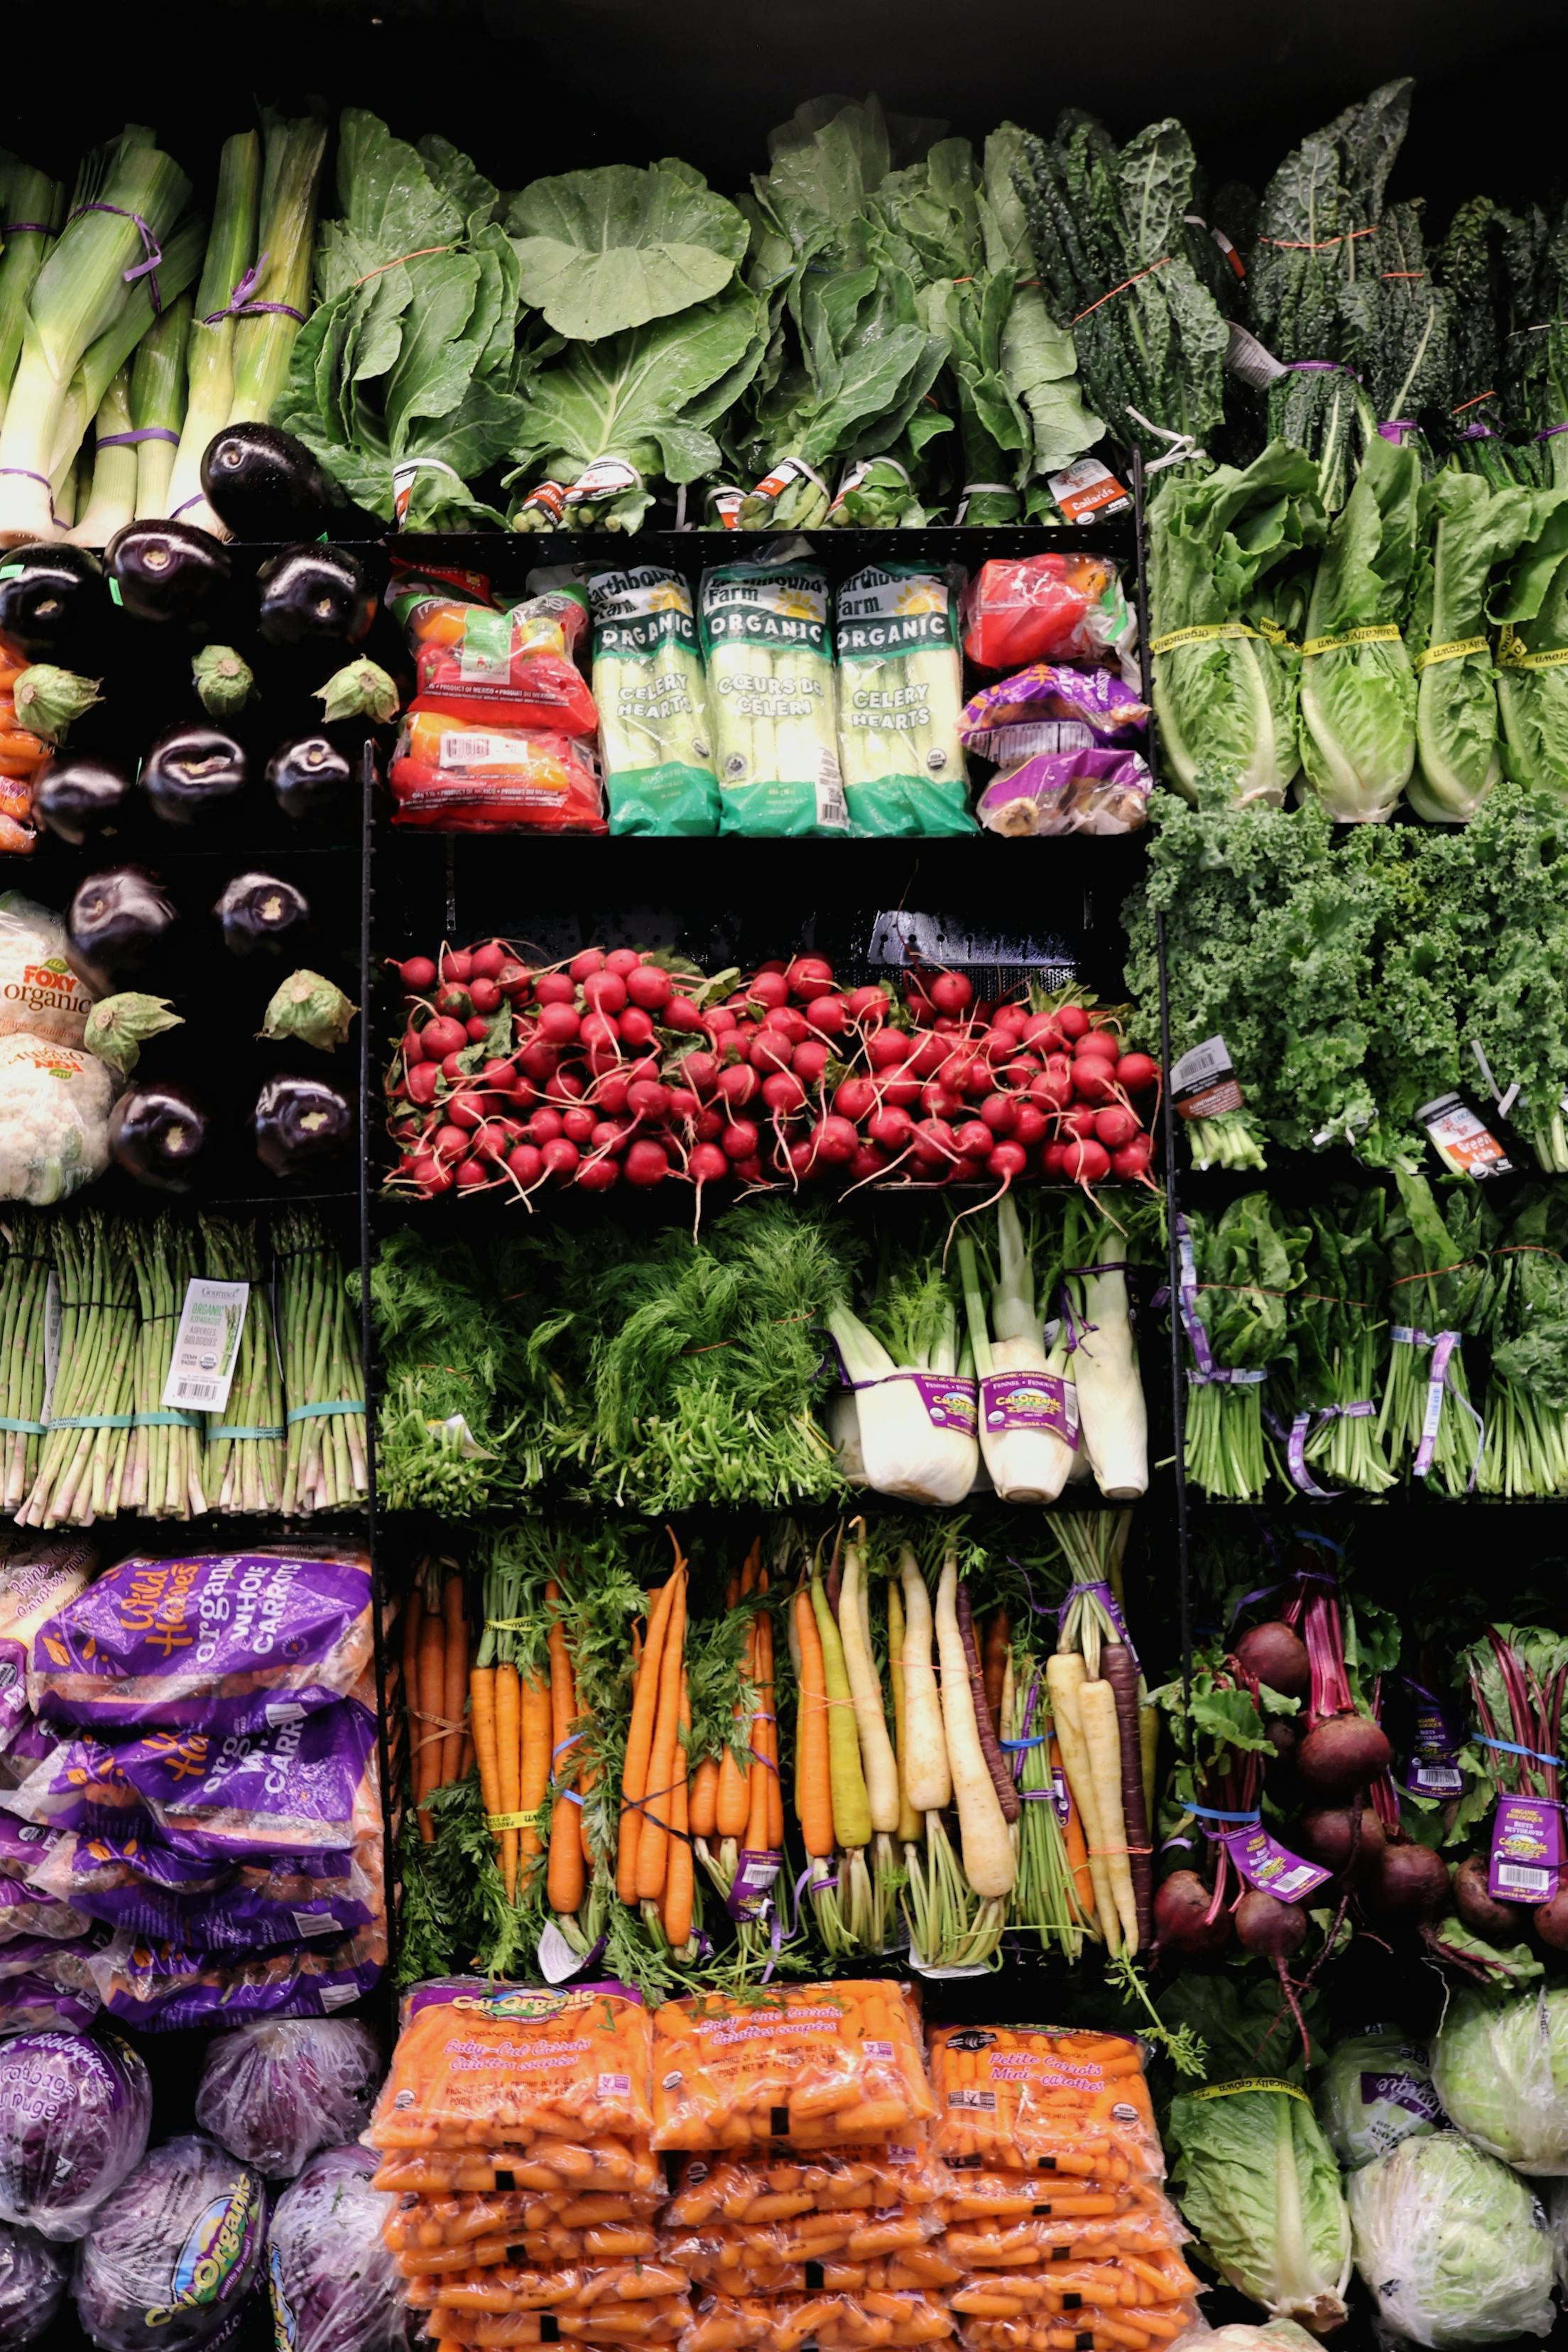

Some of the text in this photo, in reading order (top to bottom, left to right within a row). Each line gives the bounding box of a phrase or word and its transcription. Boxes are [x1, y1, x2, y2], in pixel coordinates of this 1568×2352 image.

[1072, 487, 1115, 511] Collards
[710, 585, 760, 606] Farm
[601, 614, 694, 646] ORGANIC
[710, 614, 822, 642] ORGANIC
[837, 615, 947, 649] ORGANIC
[1433, 643, 1466, 658] Grown
[440, 684, 464, 693] PRODUCT
[473, 687, 494, 695] MEXICO
[619, 672, 688, 702] CELERY
[717, 673, 796, 697] CŒURS
[852, 682, 929, 710] CELERY
[617, 695, 692, 719] HEARTS
[736, 693, 813, 717] CÉLERI
[852, 706, 932, 732] HEARTS
[23, 964, 79, 993] FOXY
[4, 984, 92, 1014] organic
[1456, 1133, 1493, 1154] Green
[192, 1302, 224, 1315] ORGANIC
[189, 1315, 222, 1327] ASPARAGUS
[189, 1325, 217, 1337] ASPERGES
[183, 1335, 218, 1348] BIOLOGIQUES
[993, 1378, 1021, 1390] FENNEL
[120, 1568, 170, 1631] Wild
[195, 1557, 243, 1664] organic
[229, 1564, 271, 1641] WHOLE
[252, 1562, 303, 1655] CARROTS
[264, 1717, 305, 1795] CARR
[783, 2005, 844, 2022] Carrots
[531, 2038, 592, 2057] Carrots
[709, 2025, 775, 2047] Carottes
[989, 2052, 1104, 2076] Petite Carrots
[991, 2067, 1106, 2094] Mini-carottes
[1219, 2079, 1253, 2092] Grown
